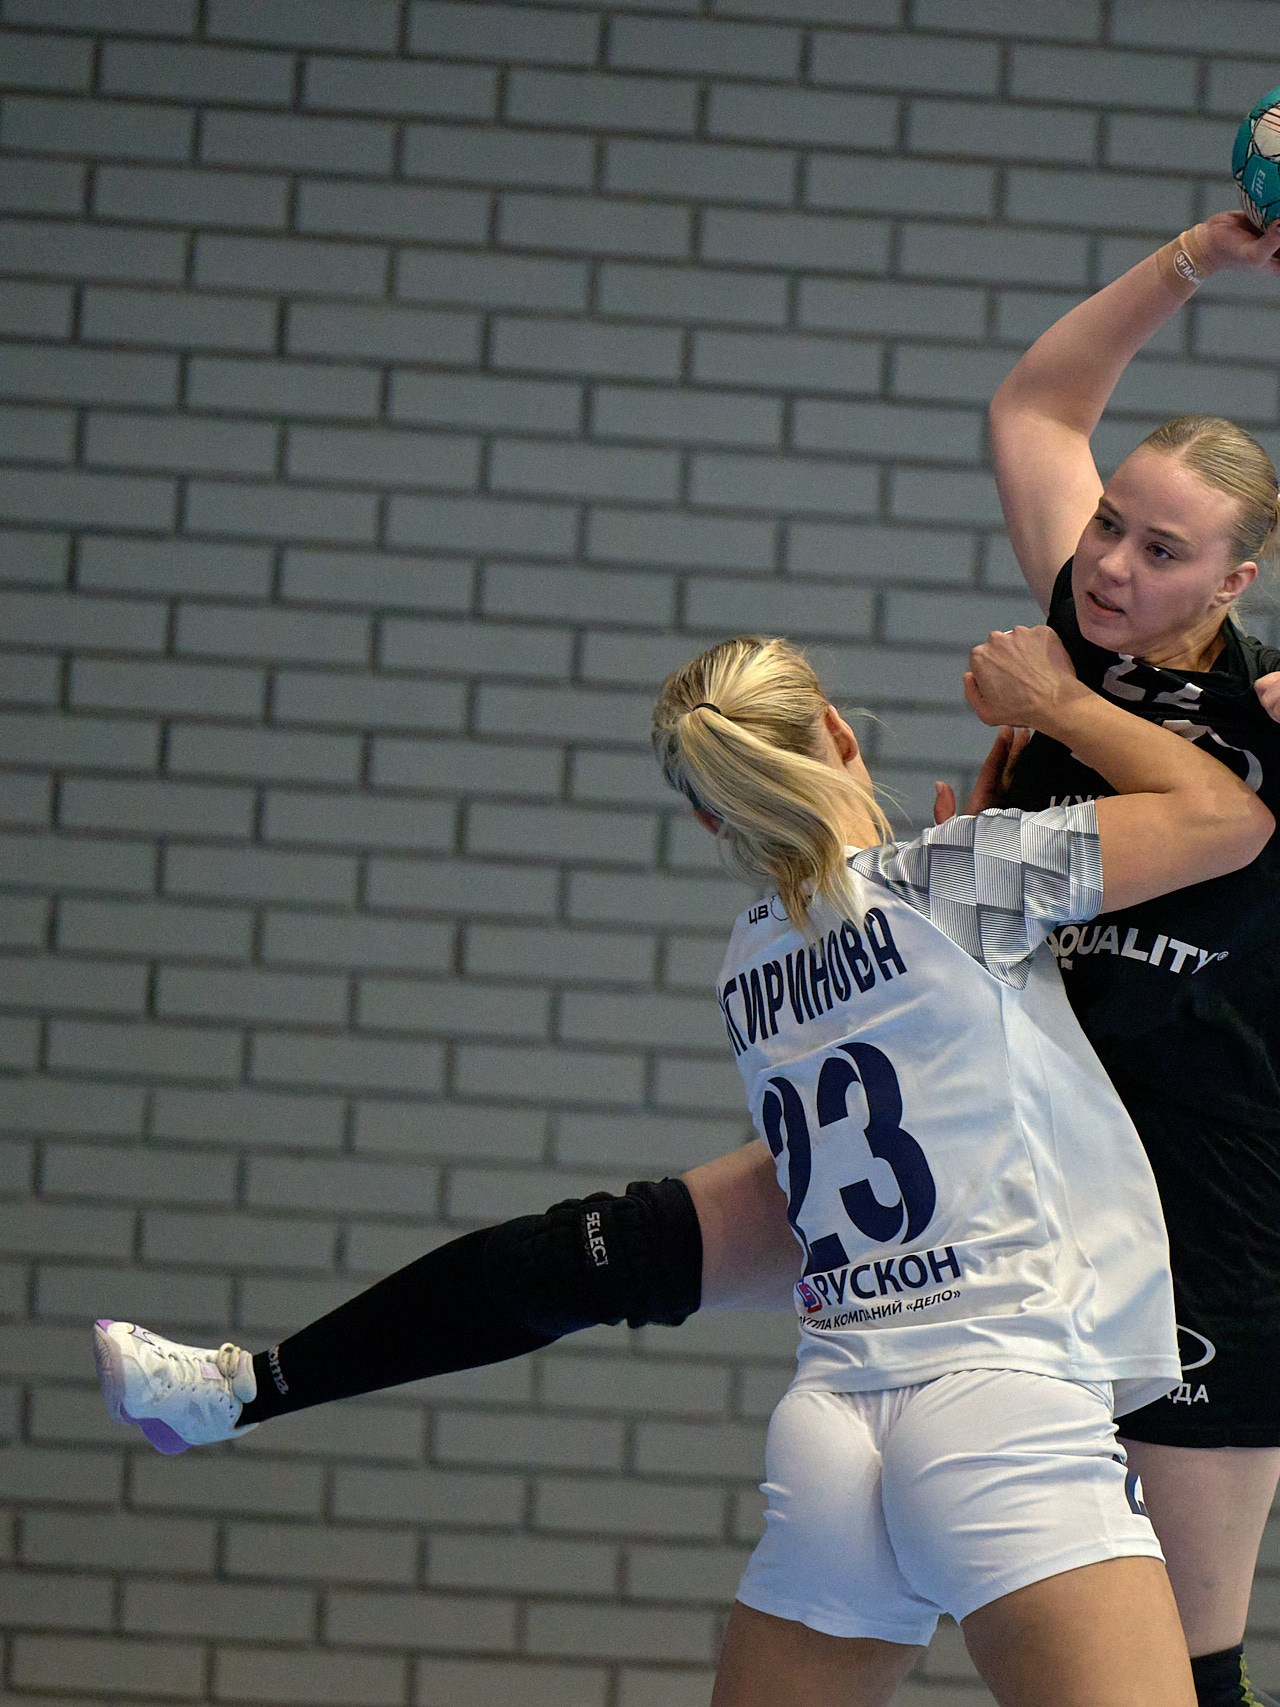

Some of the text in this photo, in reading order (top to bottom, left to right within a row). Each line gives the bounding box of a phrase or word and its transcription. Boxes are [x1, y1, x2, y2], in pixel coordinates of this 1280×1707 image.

[762, 1041, 937, 1277] 23
[586, 1211, 609, 1267] SELECT
[812, 1245, 961, 1306] РУСКОН
[833, 1299, 902, 1329] КОМПАНИЙ
[906, 1289, 961, 1311] «ДЕЛО»
[268, 1344, 290, 1395] oma
[1166, 1382, 1209, 1406] ДА
